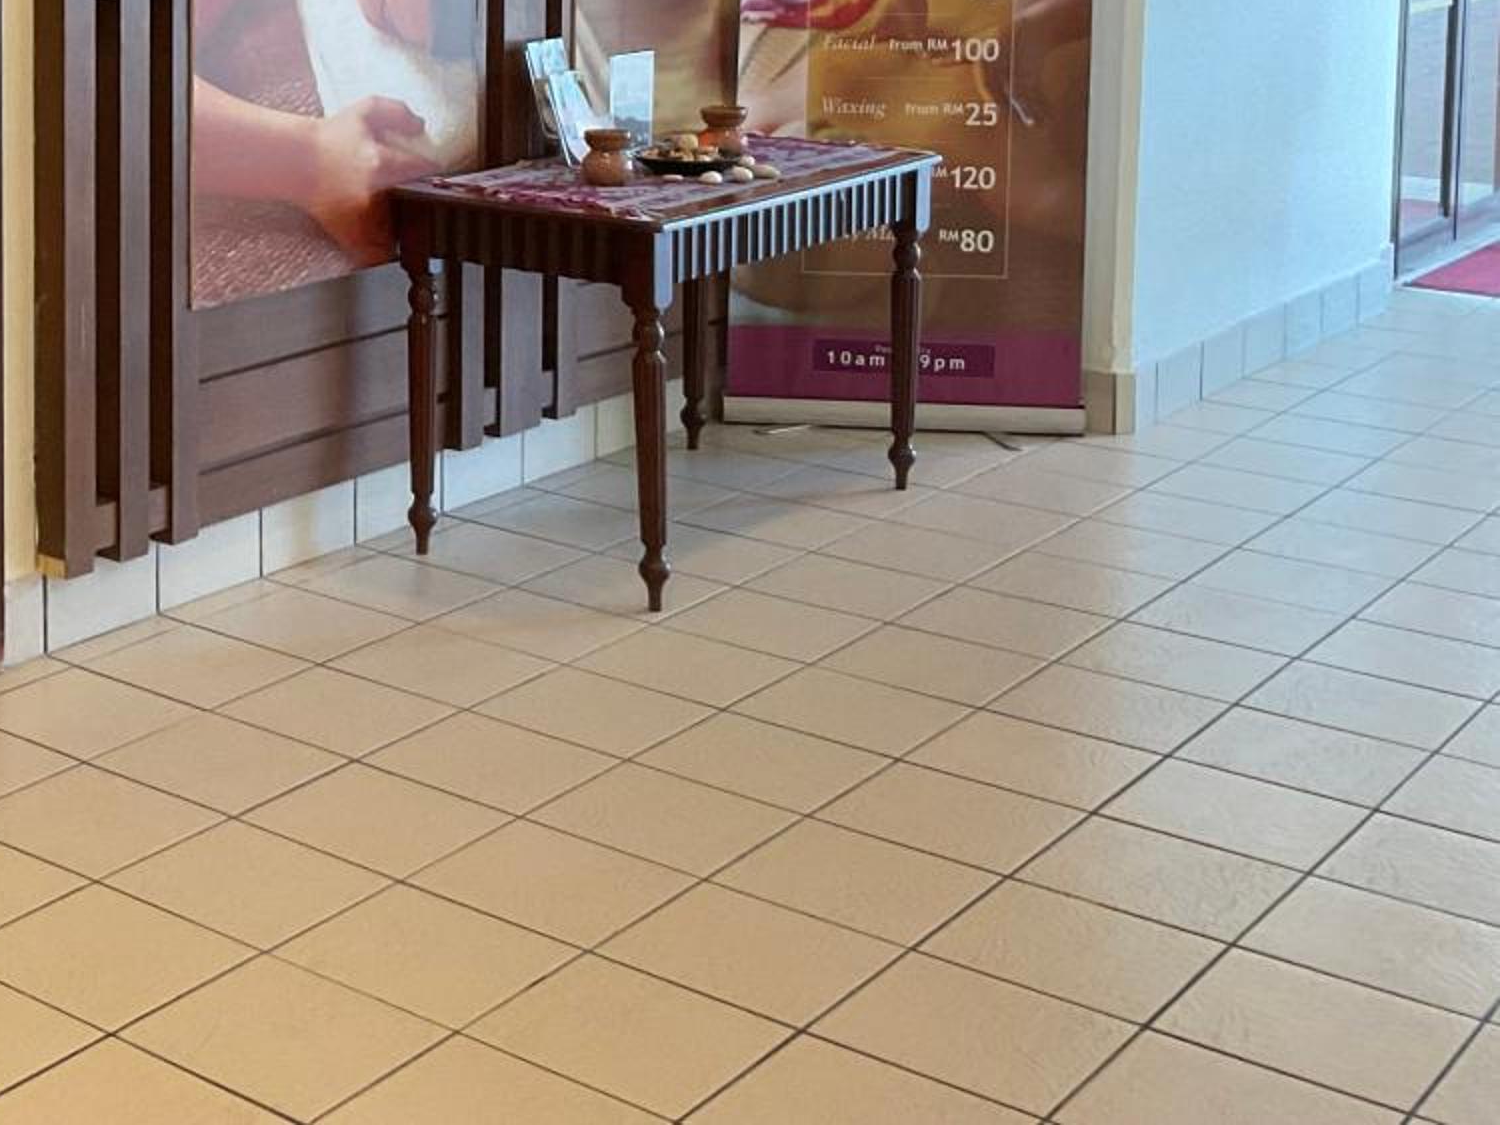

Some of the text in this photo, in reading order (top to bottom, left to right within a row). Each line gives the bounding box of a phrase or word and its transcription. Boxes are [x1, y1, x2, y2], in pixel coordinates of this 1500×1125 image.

[951, 37, 1000, 62] 100
[964, 102, 998, 126] 25
[950, 166, 997, 190] 120
[960, 229, 995, 253] 80
[826, 350, 966, 372] 10am 9pm
